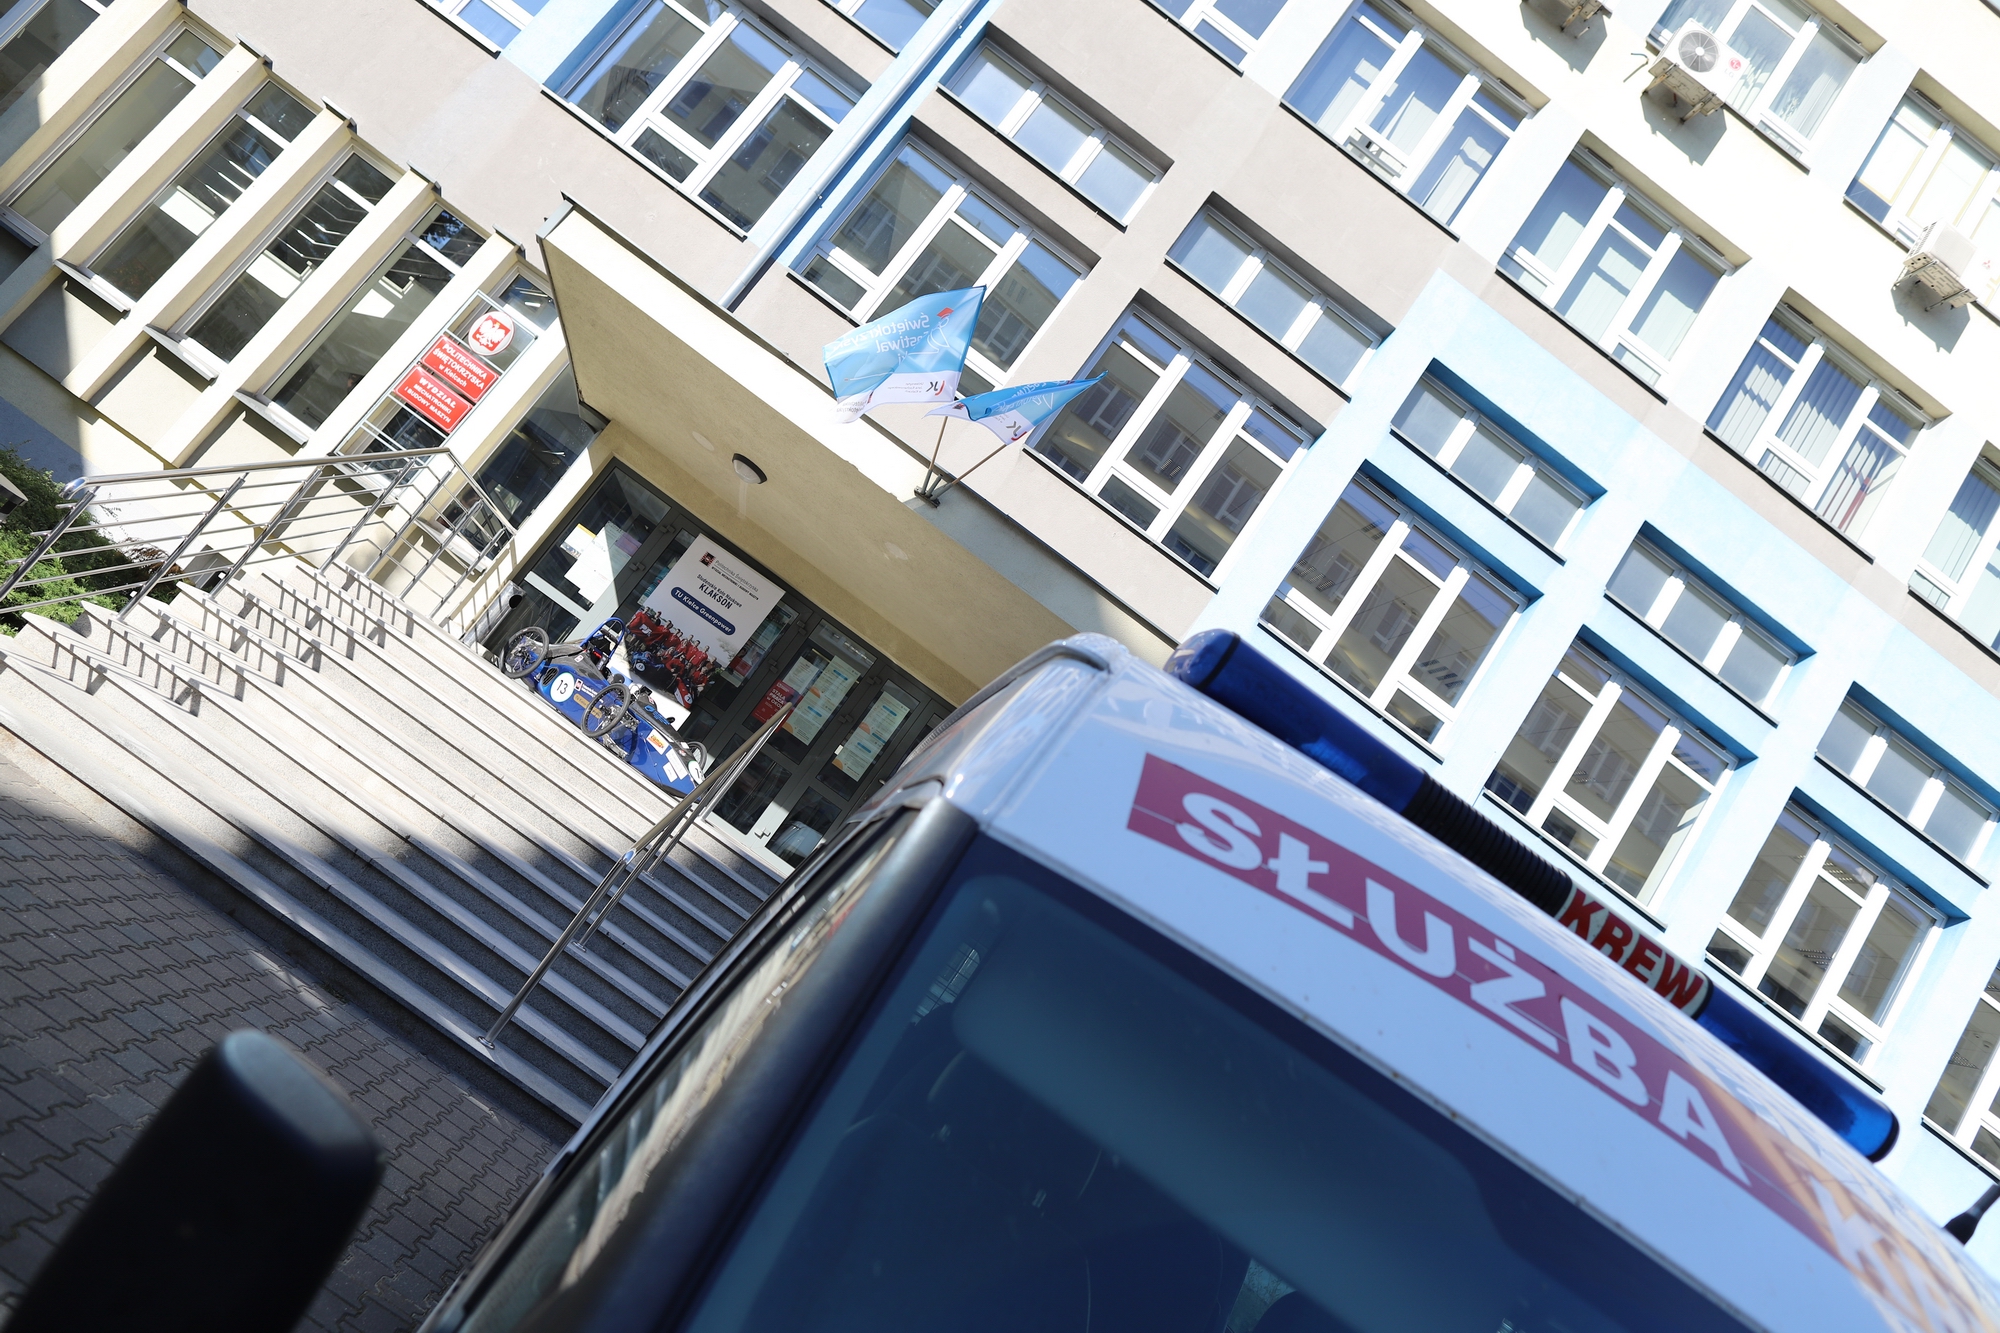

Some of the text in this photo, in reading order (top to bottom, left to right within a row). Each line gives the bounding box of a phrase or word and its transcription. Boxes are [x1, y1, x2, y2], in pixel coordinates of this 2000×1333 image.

[432, 347, 485, 390] ŚWIĘTOKRZYSKA
[442, 343, 488, 380] POLITECHNIKA
[443, 367, 468, 388] Kielcach
[407, 388, 430, 407] BUDOWY
[429, 404, 452, 423] MASZYN
[413, 383, 452, 415] MECHATRONIKI
[419, 377, 457, 409] WYDZIAŁ
[674, 589, 732, 633] TU Kielce Greenpower
[698, 583, 733, 610] KLAKSON
[556, 680, 569, 695] 13
[1558, 888, 1705, 1010] KREW
[1175, 792, 1752, 1188] SŁUŻBA
